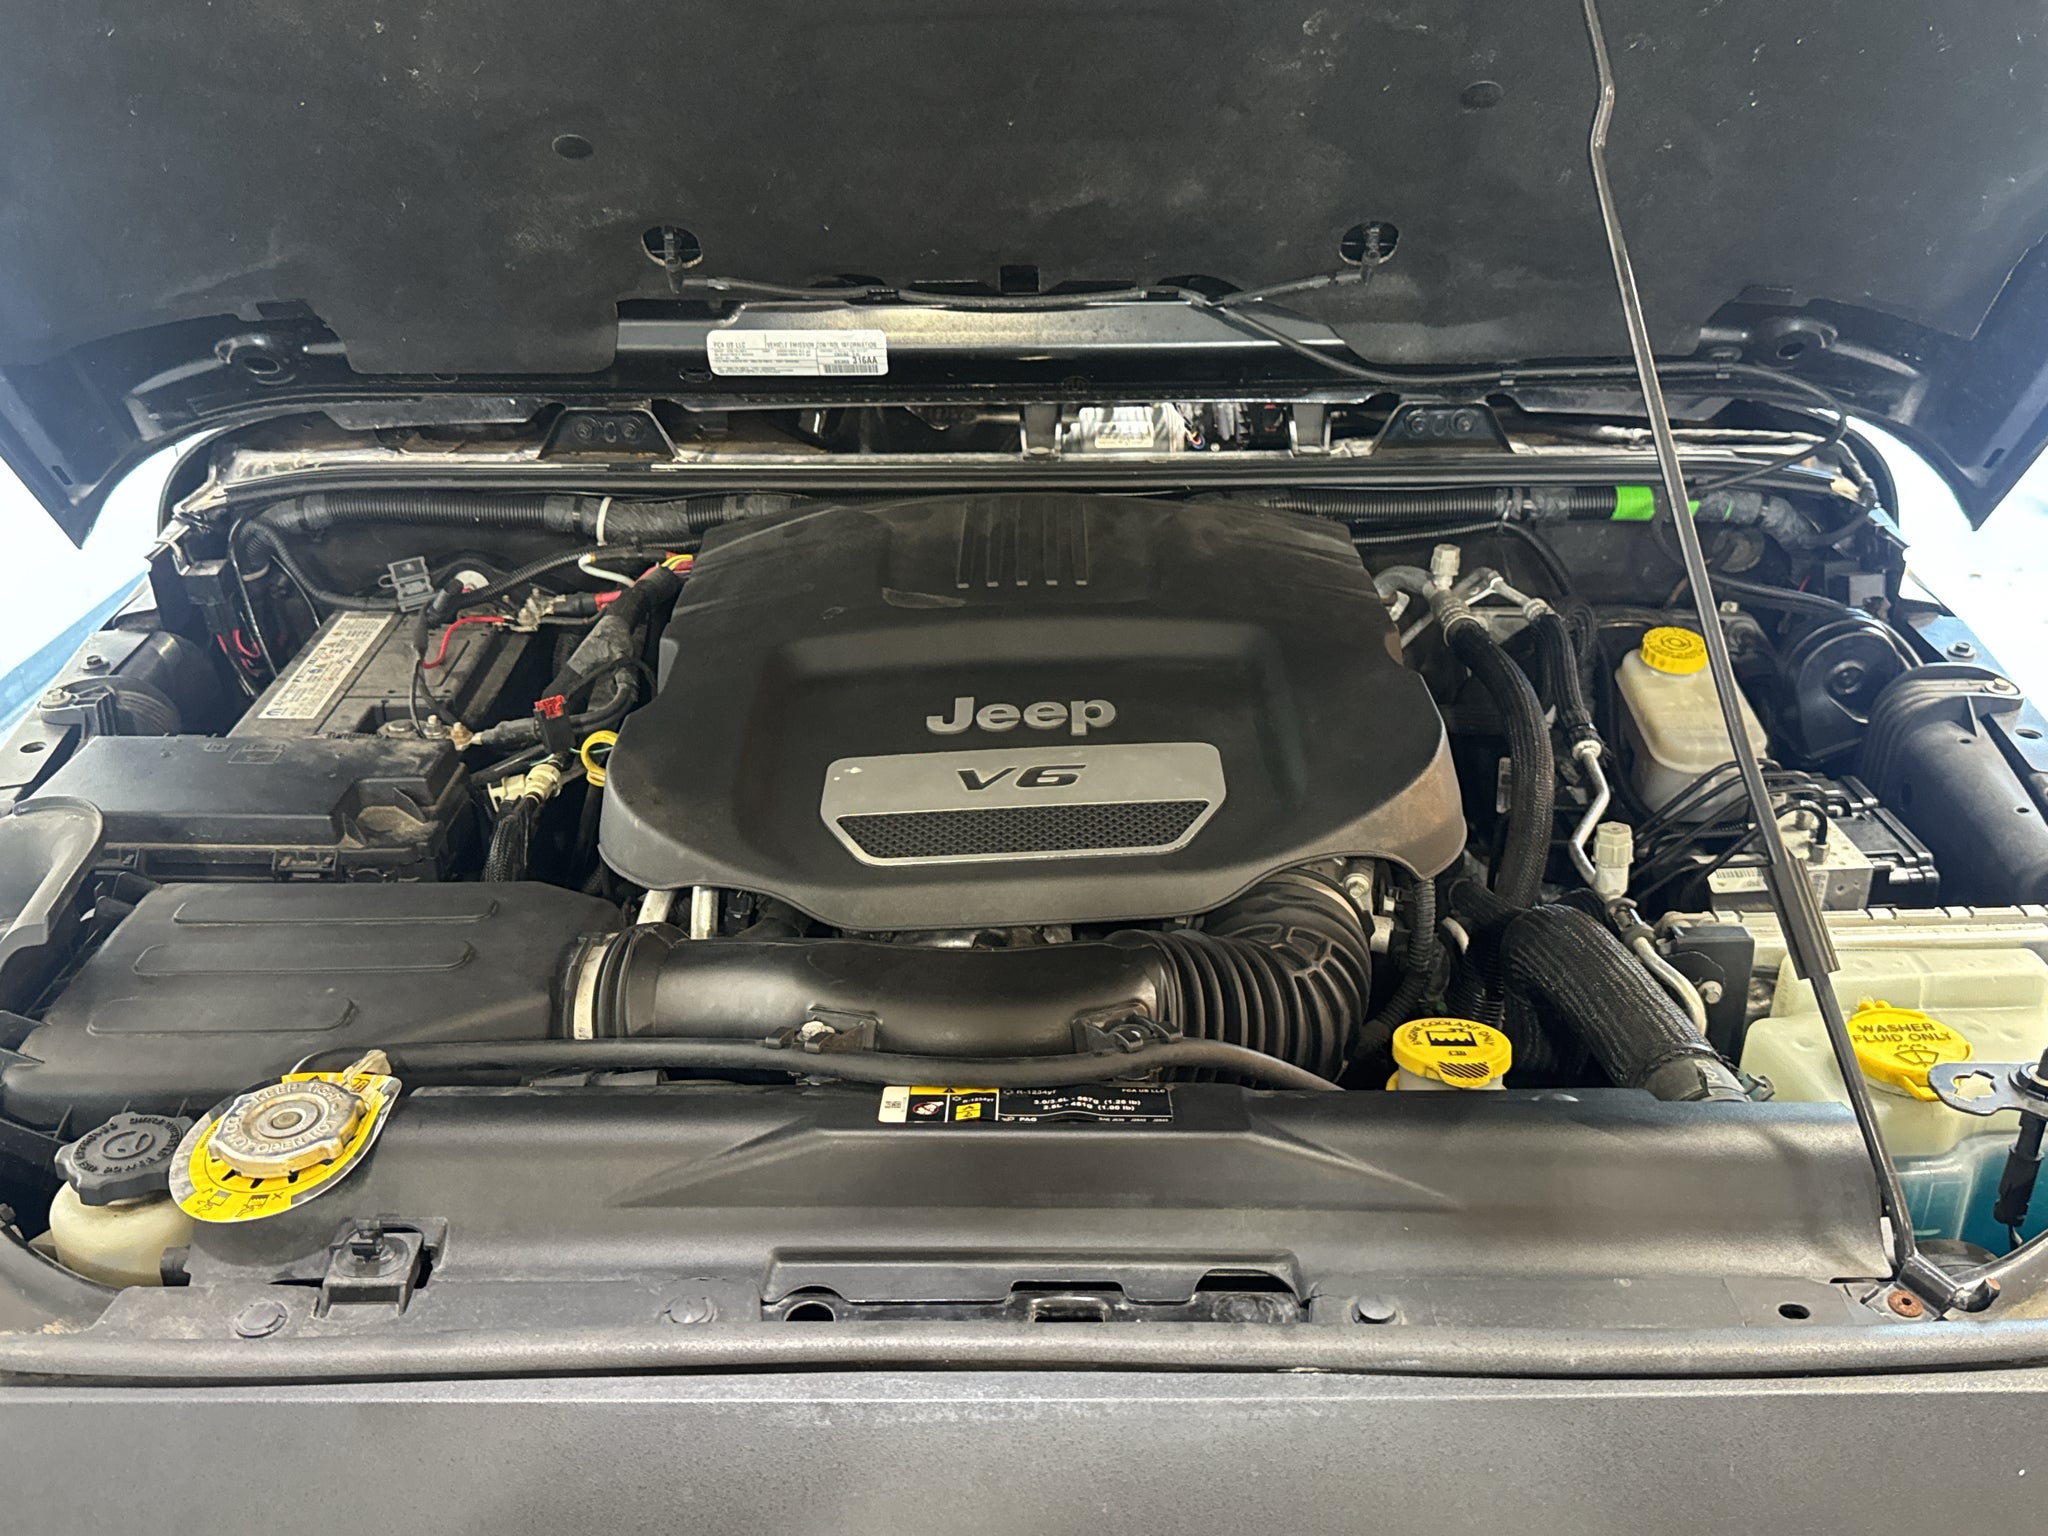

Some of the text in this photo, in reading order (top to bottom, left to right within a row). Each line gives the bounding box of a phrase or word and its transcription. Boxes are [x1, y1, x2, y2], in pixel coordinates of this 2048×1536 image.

[926, 696, 1116, 736] Jeep
[956, 764, 1087, 792] V6
[1421, 1020, 1481, 1031] COOLANT
[1478, 1030, 1496, 1046] ONLY
[1852, 1031, 1952, 1043] FLUID ONLY
[1856, 1022, 1936, 1033] WASHER
[254, 1081, 344, 1102] KEEP TIGHT
[256, 1137, 305, 1153] OPEN
[309, 1119, 338, 1138] HOT
